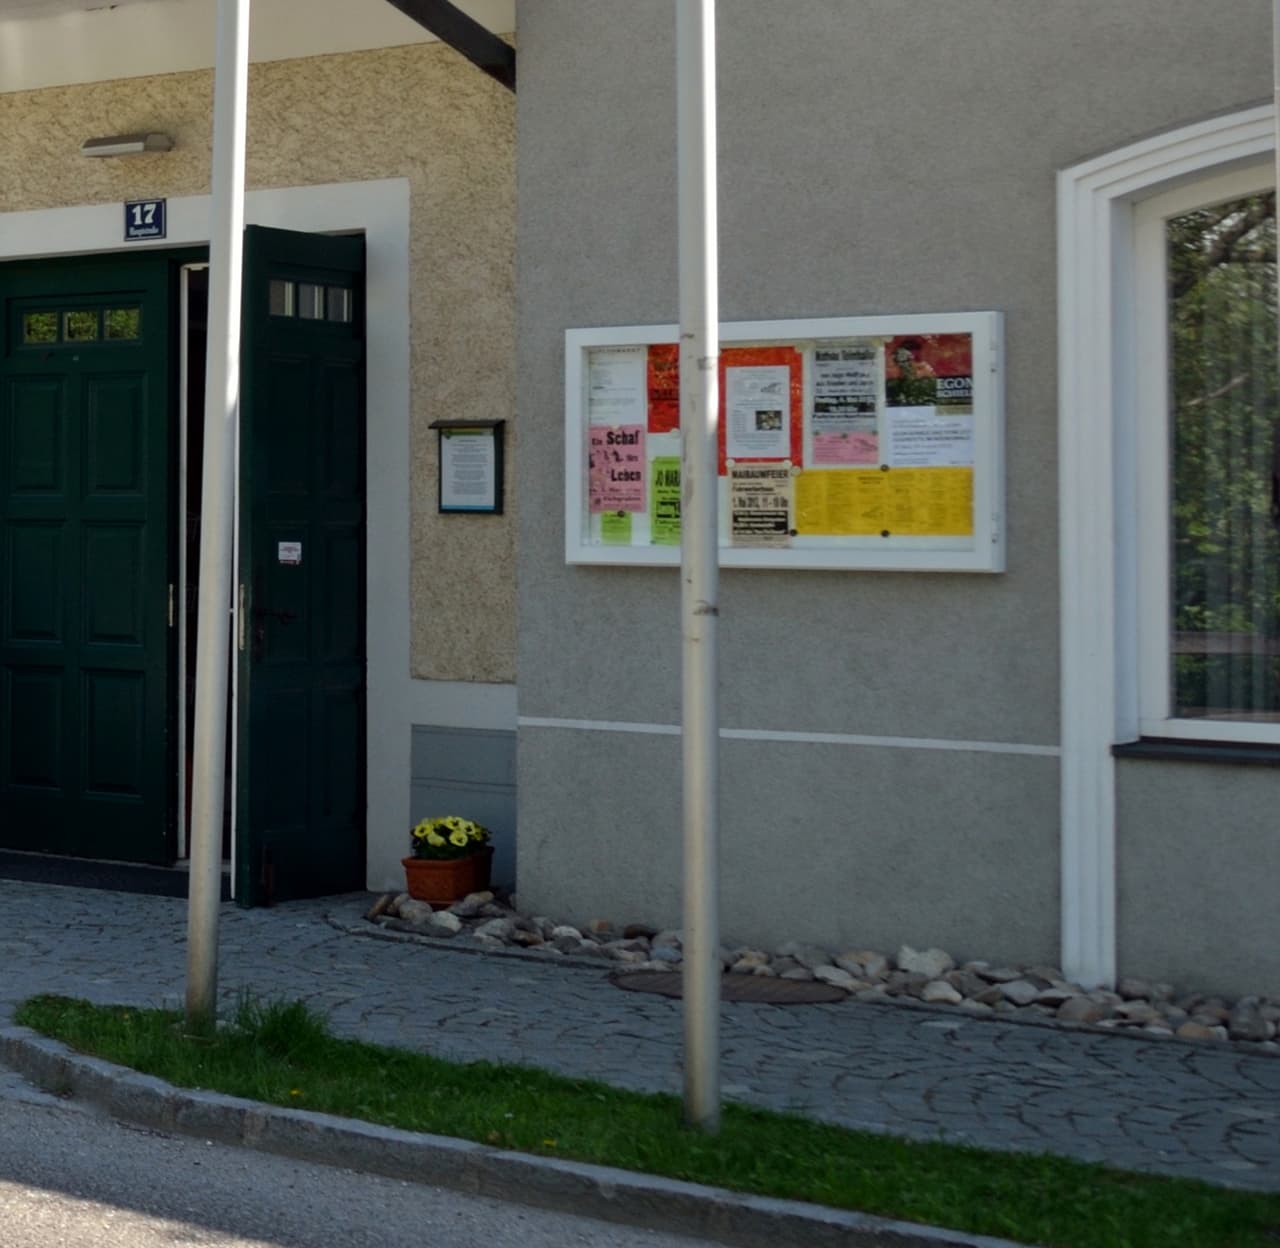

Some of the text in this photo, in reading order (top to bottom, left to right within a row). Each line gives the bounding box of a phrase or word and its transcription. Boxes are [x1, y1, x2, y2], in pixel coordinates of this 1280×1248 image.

[131, 203, 157, 225] 17
[606, 430, 640, 446] Schaf
[611, 469, 642, 482] Leben
